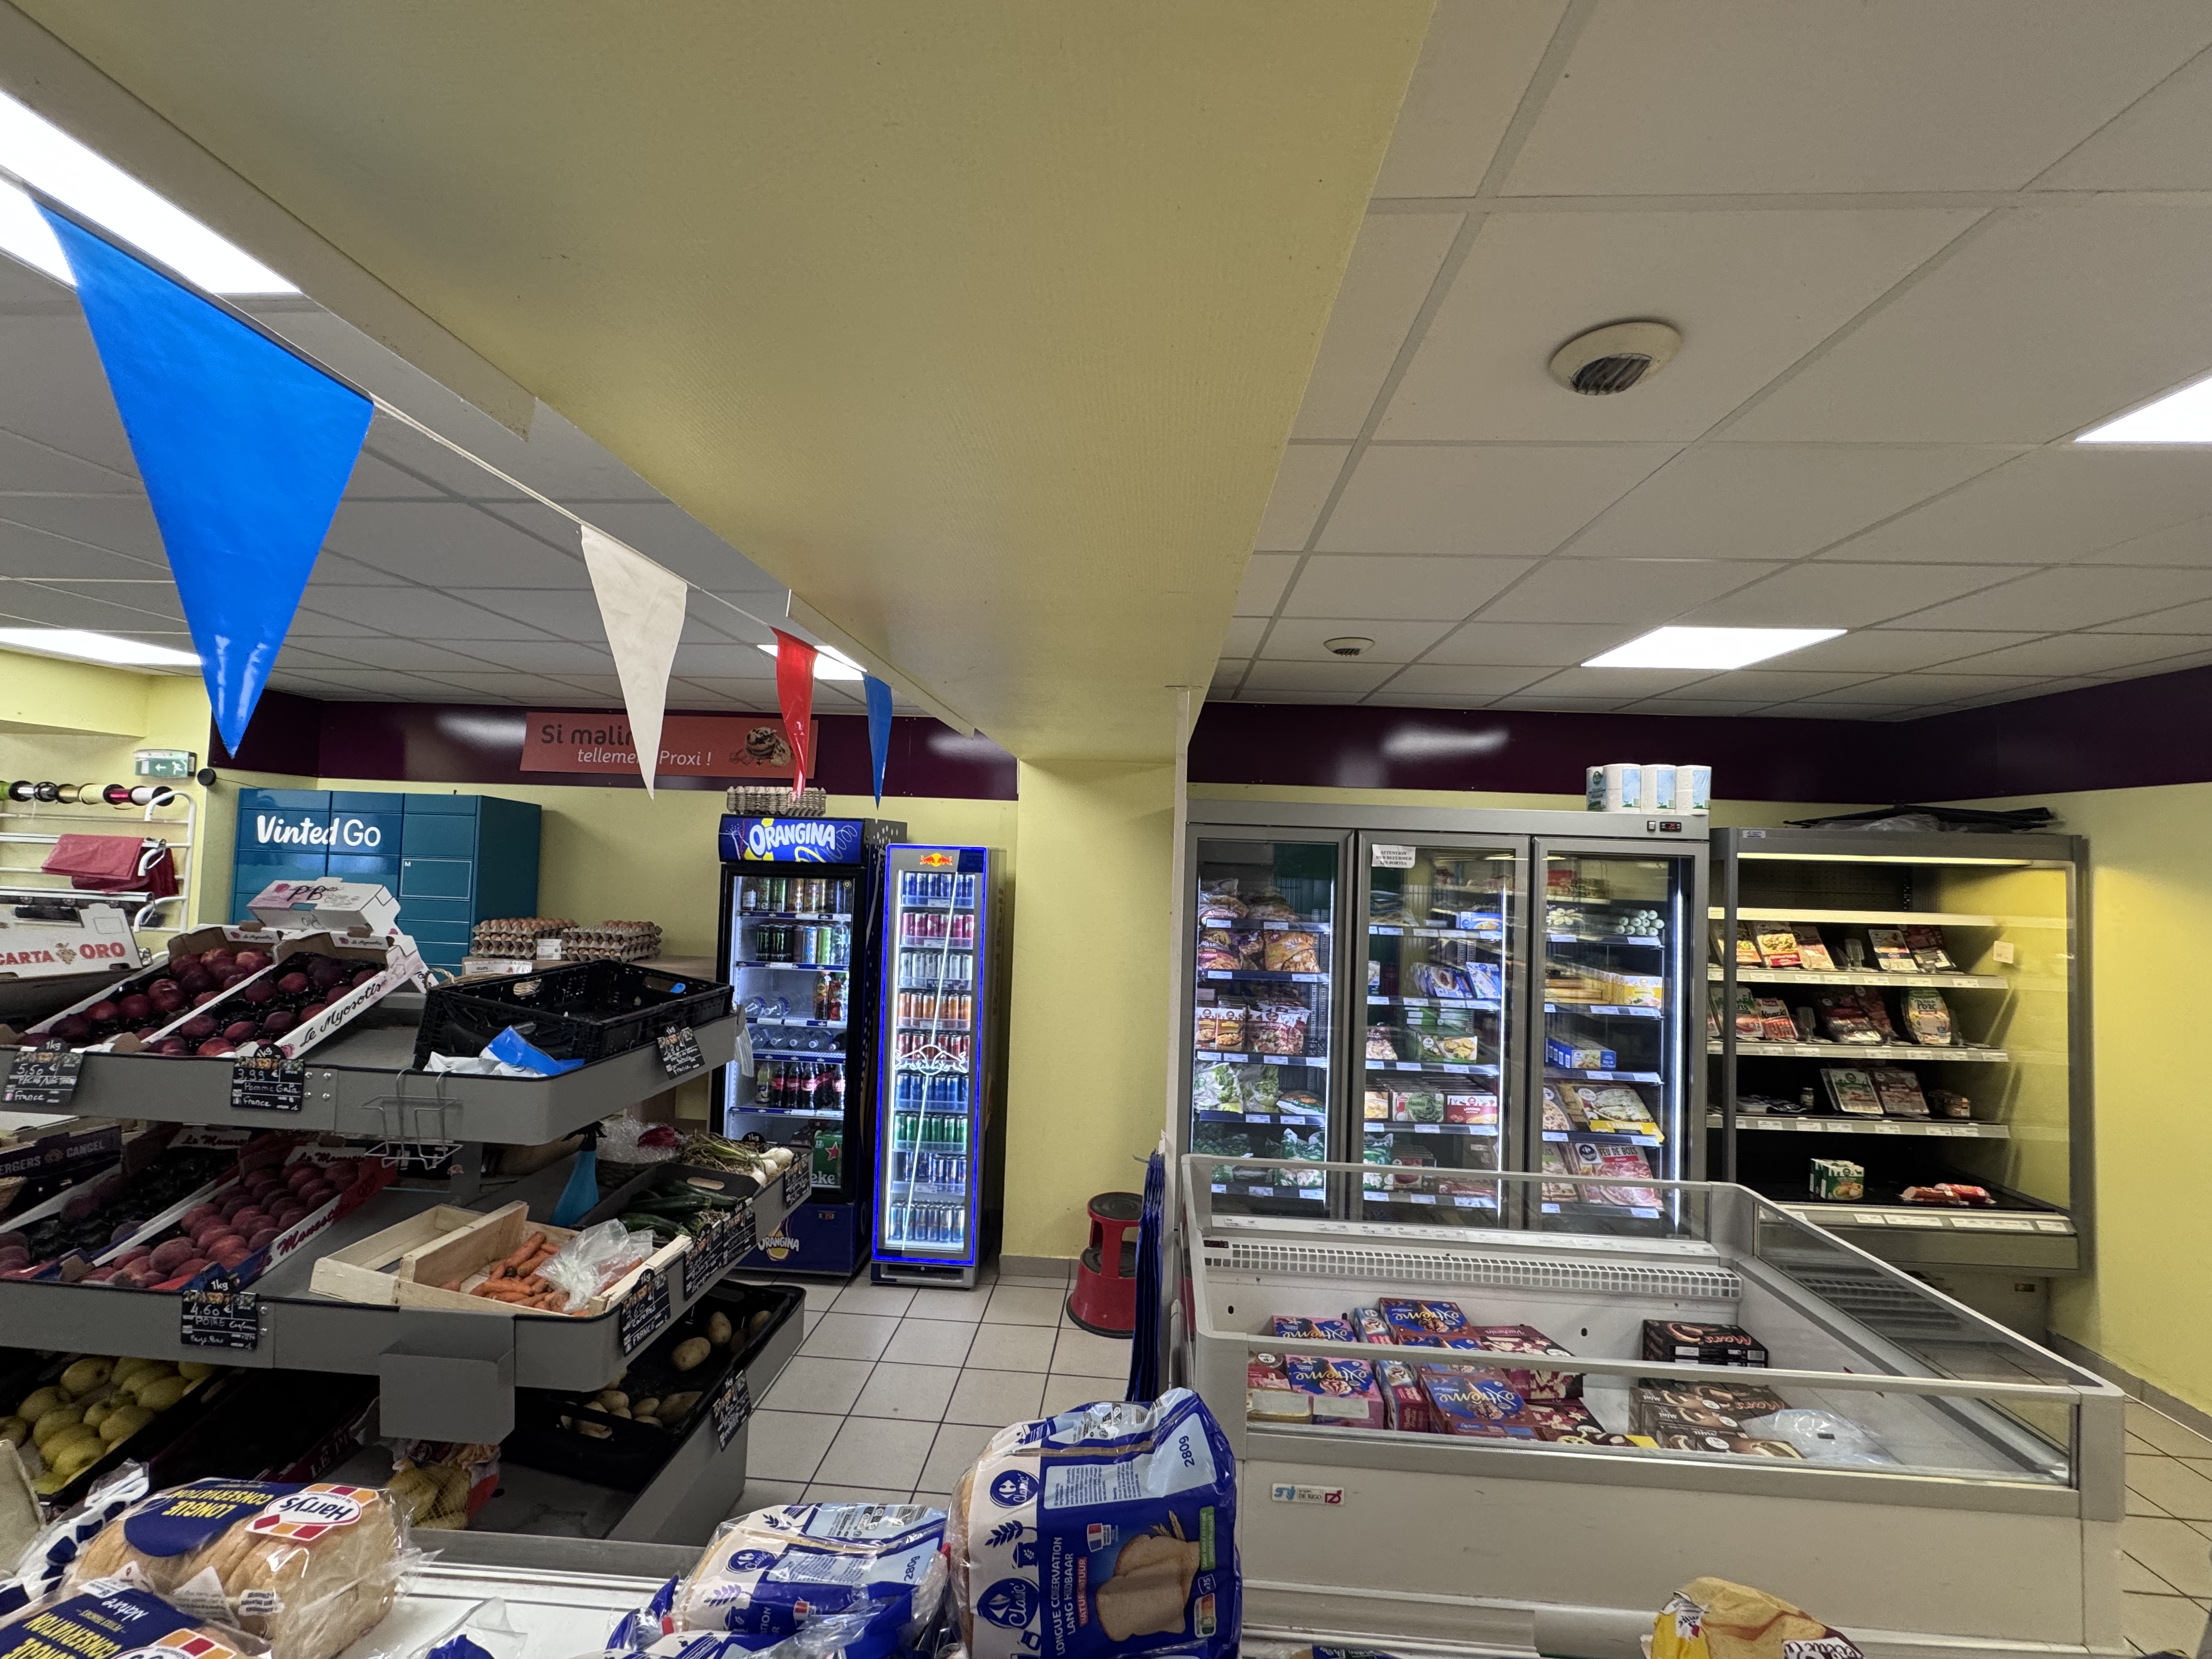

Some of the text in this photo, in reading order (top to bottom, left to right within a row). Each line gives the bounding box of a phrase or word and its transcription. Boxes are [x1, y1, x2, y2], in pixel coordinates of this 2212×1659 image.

[541, 724, 563, 744] Si
[578, 747, 712, 766] telleme Proxi !
[257, 815, 381, 847] Vinted Go
[749, 822, 836, 856] ORANGINA
[80, 942, 126, 959] ORO
[300, 979, 386, 1047] Le Myosotis
[46, 1040, 61, 1051] 1kg
[256, 1046, 273, 1058] 1kg
[244, 1082, 301, 1094] Pomme Gala
[243, 1096, 272, 1107] France
[1599, 1146, 1638, 1156] FEU DE BOIS
[211, 1278, 229, 1291] 1kg
[640, 1272, 651, 1285] 1kg
[633, 1321, 655, 1346] FRANCE
[1178, 1435, 1195, 1468] 280g
[169, 1488, 275, 1505] CONSERVATION
[1013, 1474, 1029, 1503] Claic'
[161, 1500, 238, 1520] LONGUE
[904, 1555, 921, 1582] 280g
[1203, 1578, 1211, 1590] x15
[101, 1599, 149, 1622] Nature
[1008, 1583, 1027, 1627] Claic'
[1064, 1602, 1076, 1635] LANG
[22, 1611, 122, 1659] CONSERVATION
[1052, 1606, 1065, 1656] LONGUE
